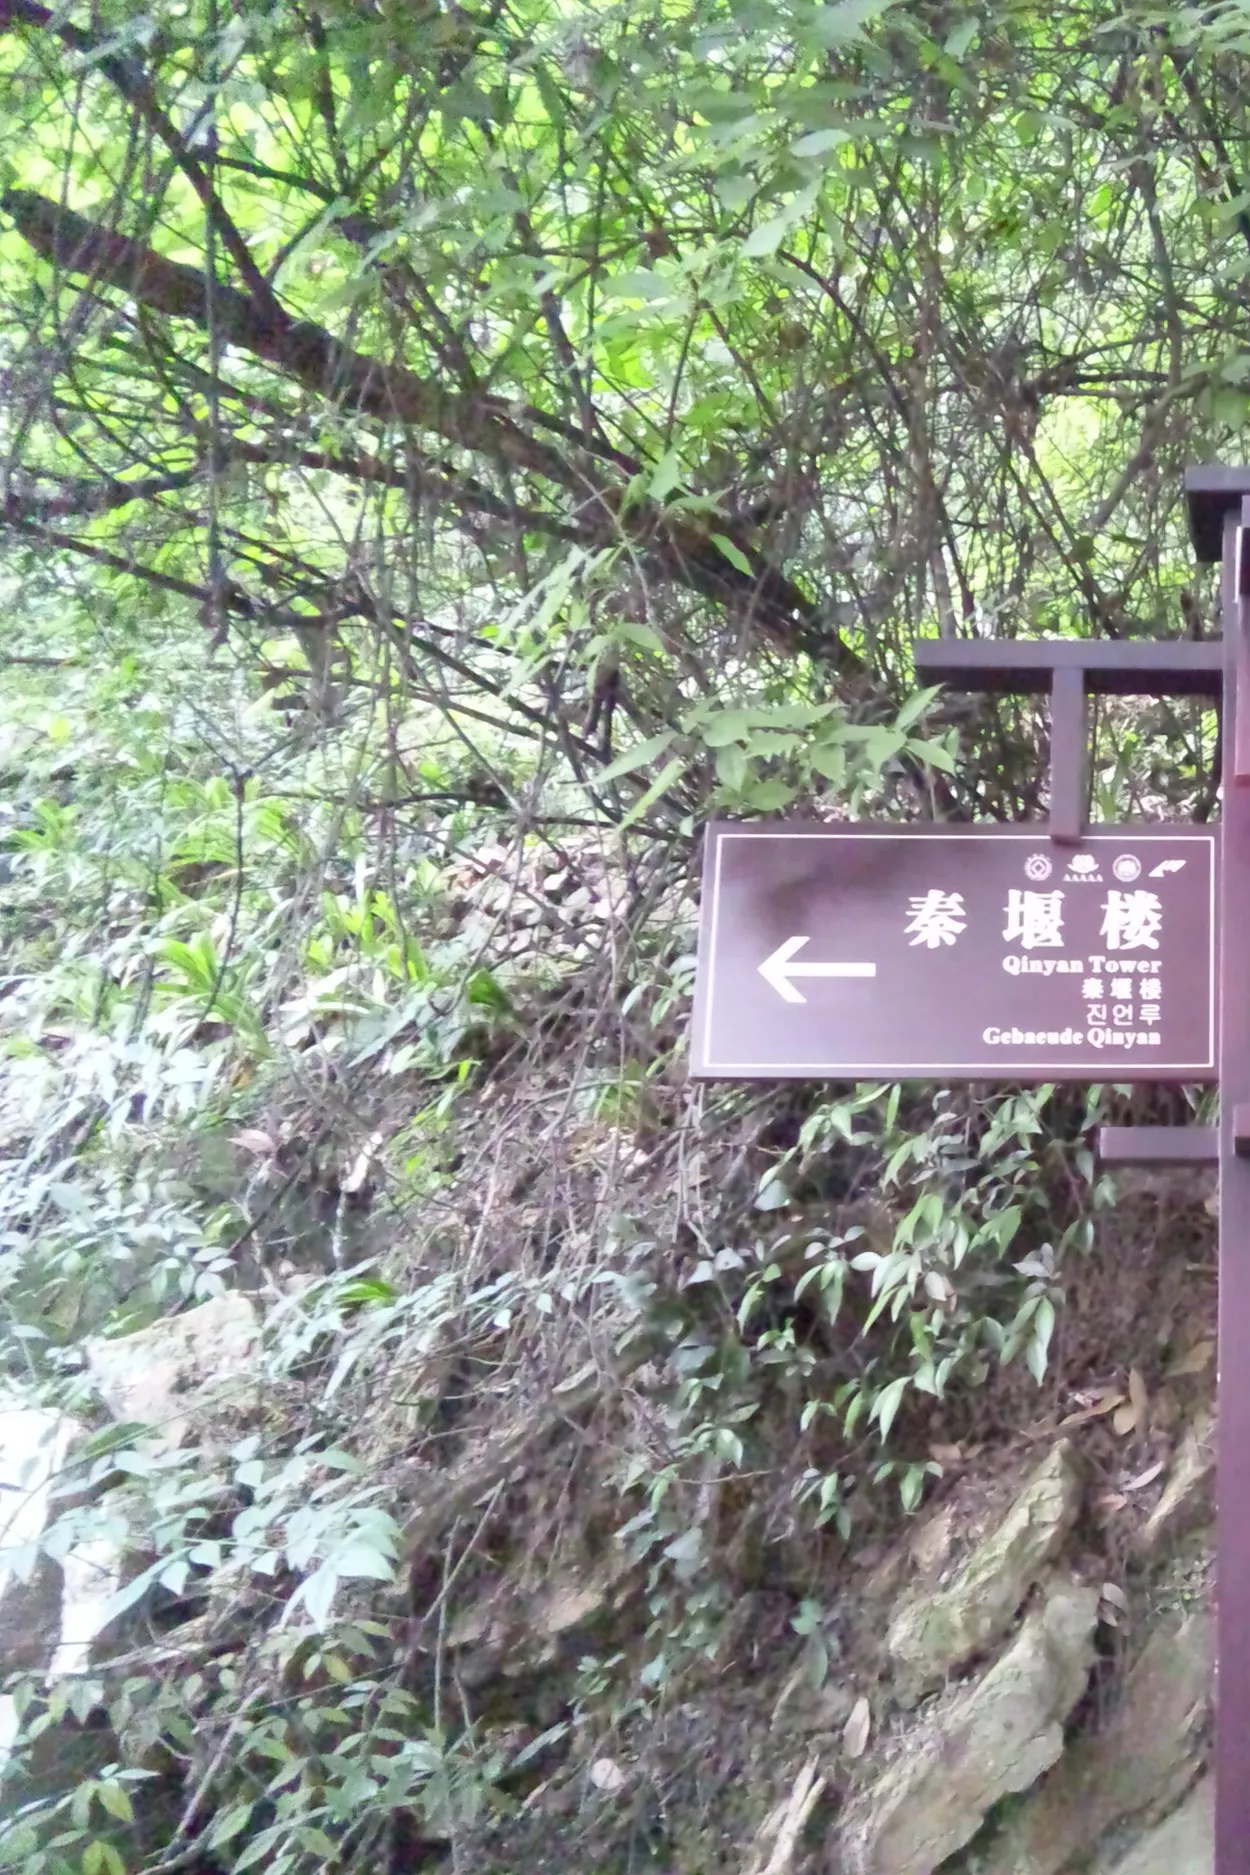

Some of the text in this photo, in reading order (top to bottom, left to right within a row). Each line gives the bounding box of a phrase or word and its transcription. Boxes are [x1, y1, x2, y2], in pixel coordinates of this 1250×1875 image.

[903, 888, 1163, 951] 秦堰楼
[1002, 955, 1162, 977] Qinyan Tower
[1086, 1027, 1161, 1049] Qinyan
